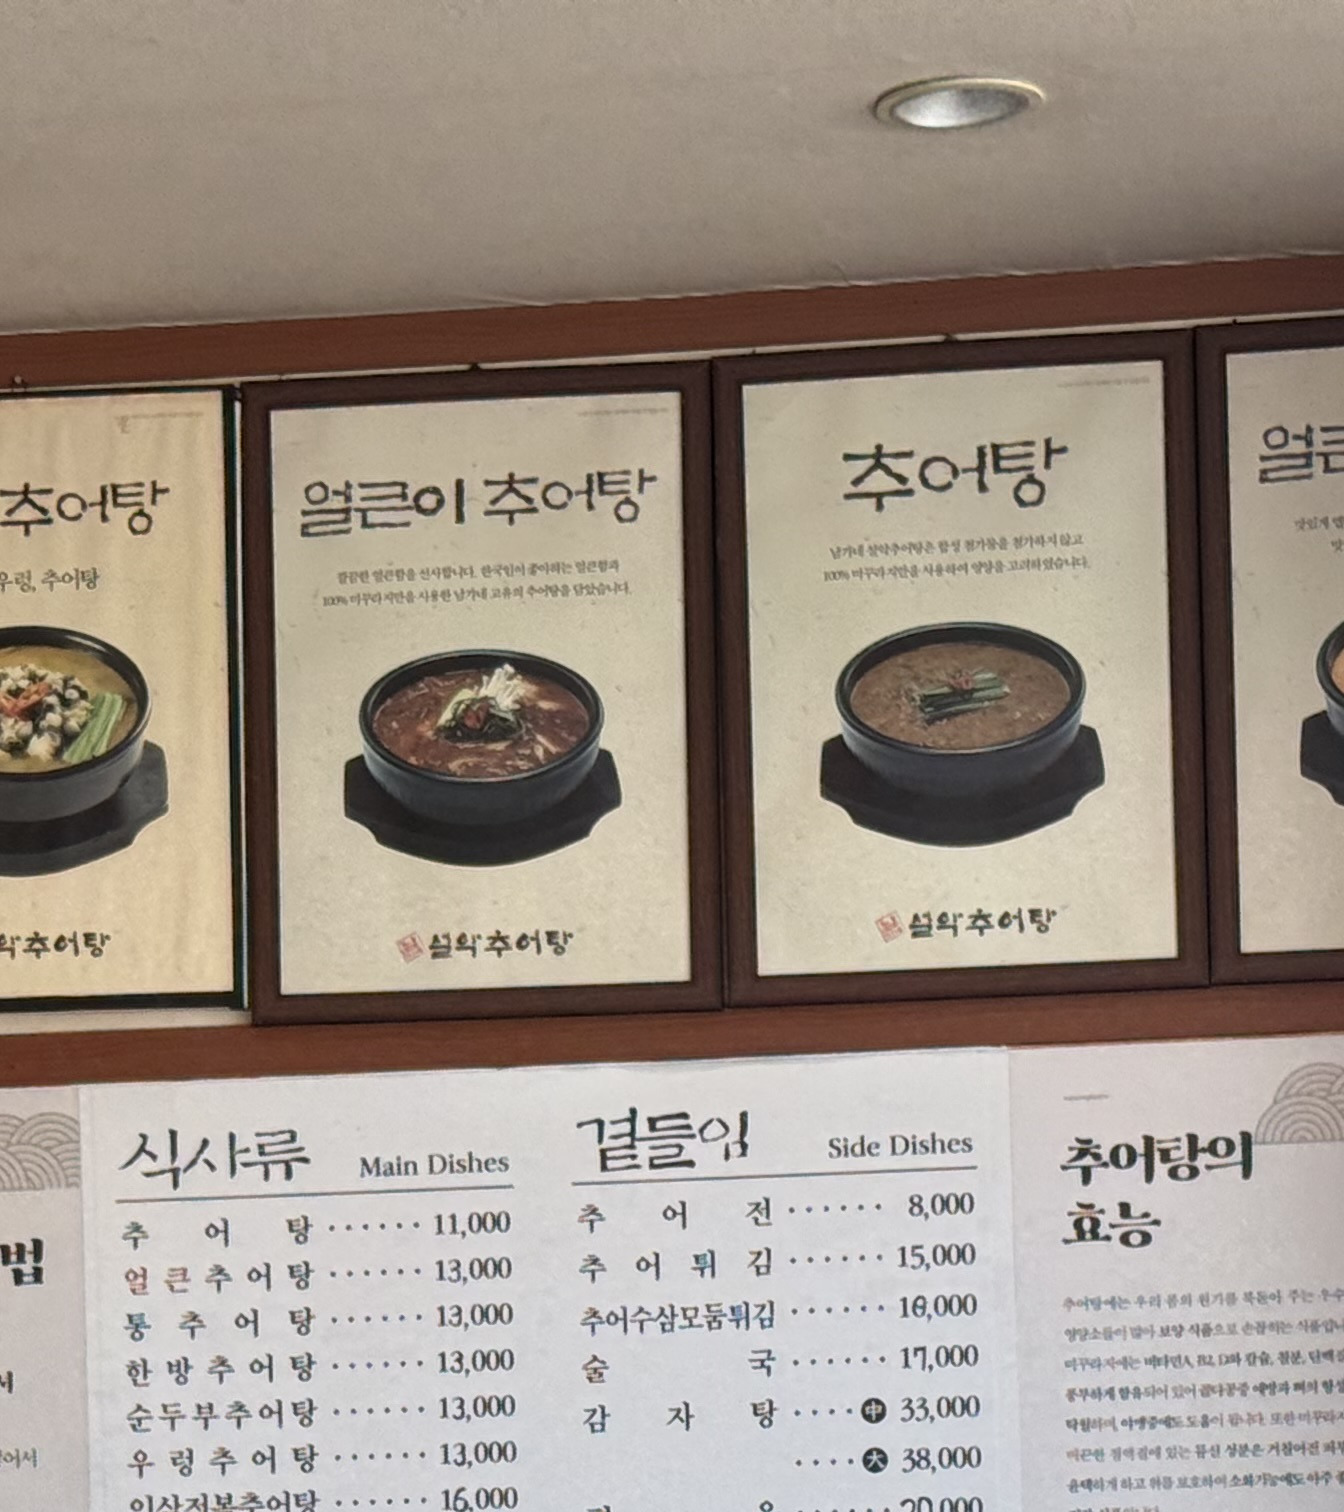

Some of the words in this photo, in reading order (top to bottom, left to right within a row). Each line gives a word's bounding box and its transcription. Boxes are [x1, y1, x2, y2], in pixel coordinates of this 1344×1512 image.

[843, 436, 1068, 513] 추어탕
[300, 477, 466, 538] 얼큰이
[483, 468, 657, 525] 추어탕
[40, 567, 100, 591] 추어탕
[907, 907, 1057, 939] 설악추어탕
[428, 929, 574, 959] 설악추어탕
[577, 1107, 749, 1173] 곁들임
[828, 1135, 881, 1161] Side
[889, 1131, 973, 1157] Dishes
[118, 1128, 311, 1192] 식사류
[359, 1155, 419, 1179] Main
[427, 1150, 510, 1175] Dishes
[1060, 1130, 1254, 1187] 추어탕의
[908, 1192, 975, 1220] 8,000
[434, 1210, 512, 1240] 11,000
[1061, 1201, 1162, 1249] 효능
[435, 1256, 513, 1286] 13,000
[897, 1243, 976, 1273] 15,000
[436, 1302, 514, 1331] 13,000
[580, 1299, 776, 1338] 추어수삼모둠튀김
[437, 1348, 516, 1378] 13,000
[900, 1344, 979, 1373] 17,000
[438, 1393, 517, 1421] 13,000
[900, 1395, 981, 1425] 33,000
[439, 1440, 518, 1468] 13,000
[901, 1445, 982, 1475] 38,000
